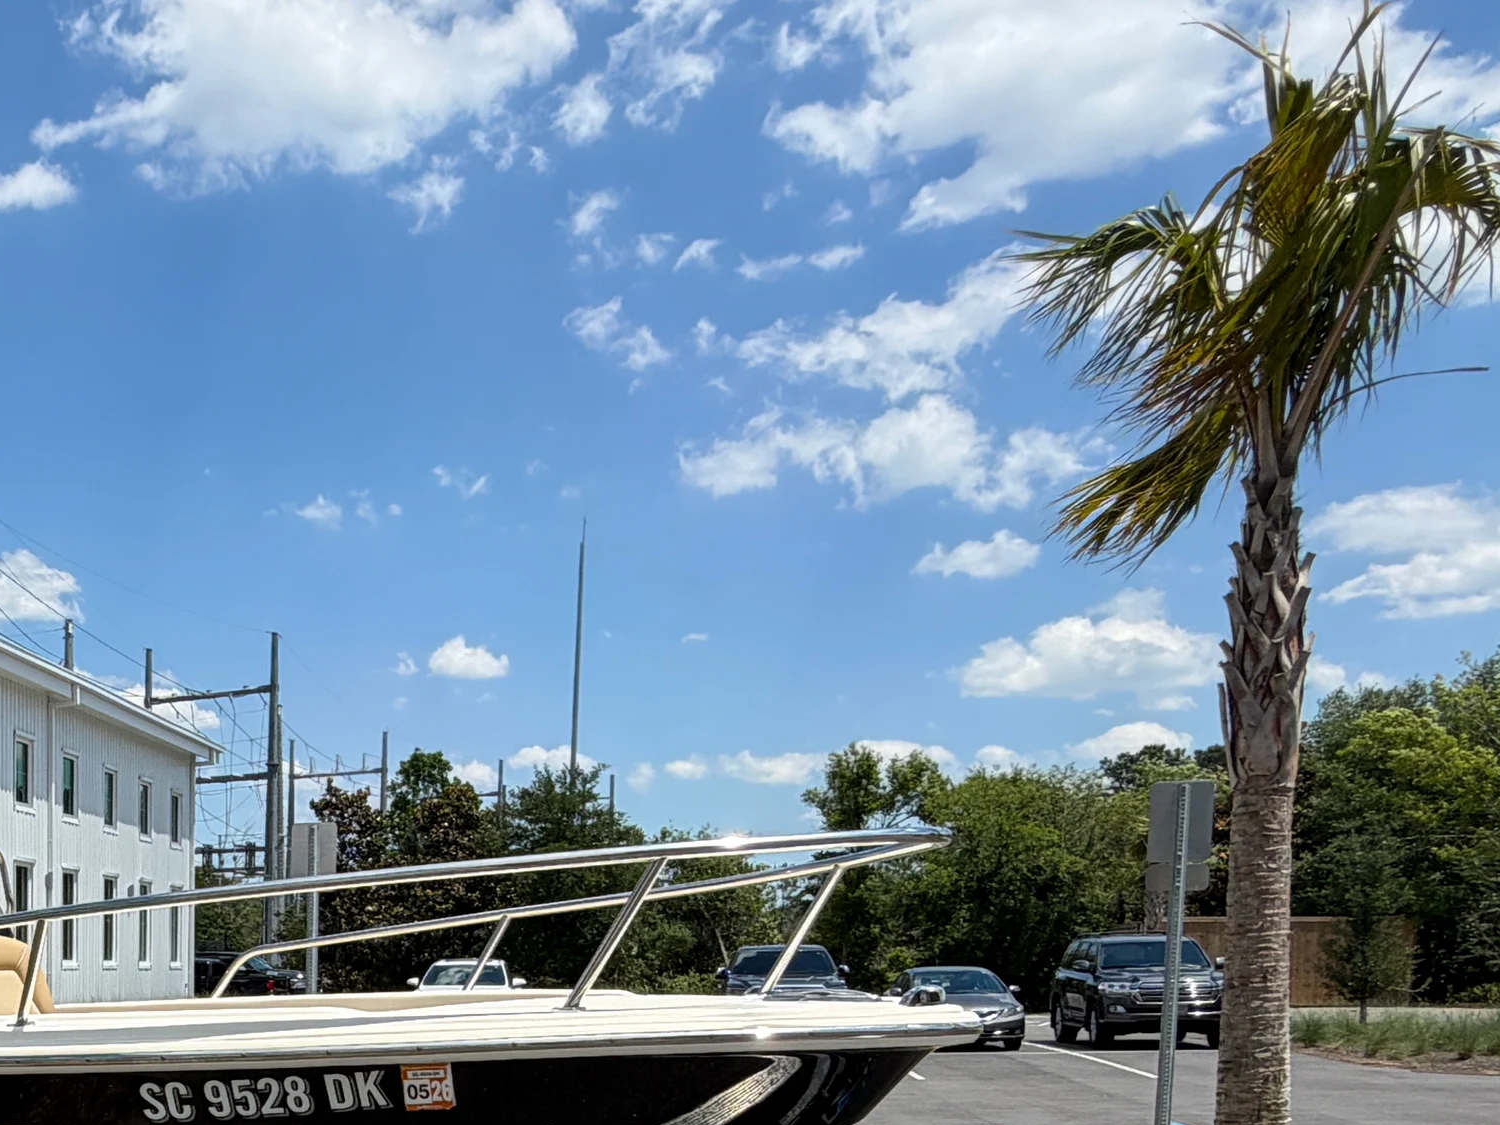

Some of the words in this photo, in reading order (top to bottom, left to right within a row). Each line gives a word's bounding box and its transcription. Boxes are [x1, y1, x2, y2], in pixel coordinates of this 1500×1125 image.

[140, 1081, 194, 1122] SC
[203, 1075, 314, 1120] 9528
[323, 1069, 392, 1112] DK
[407, 1084, 430, 1100] 05
